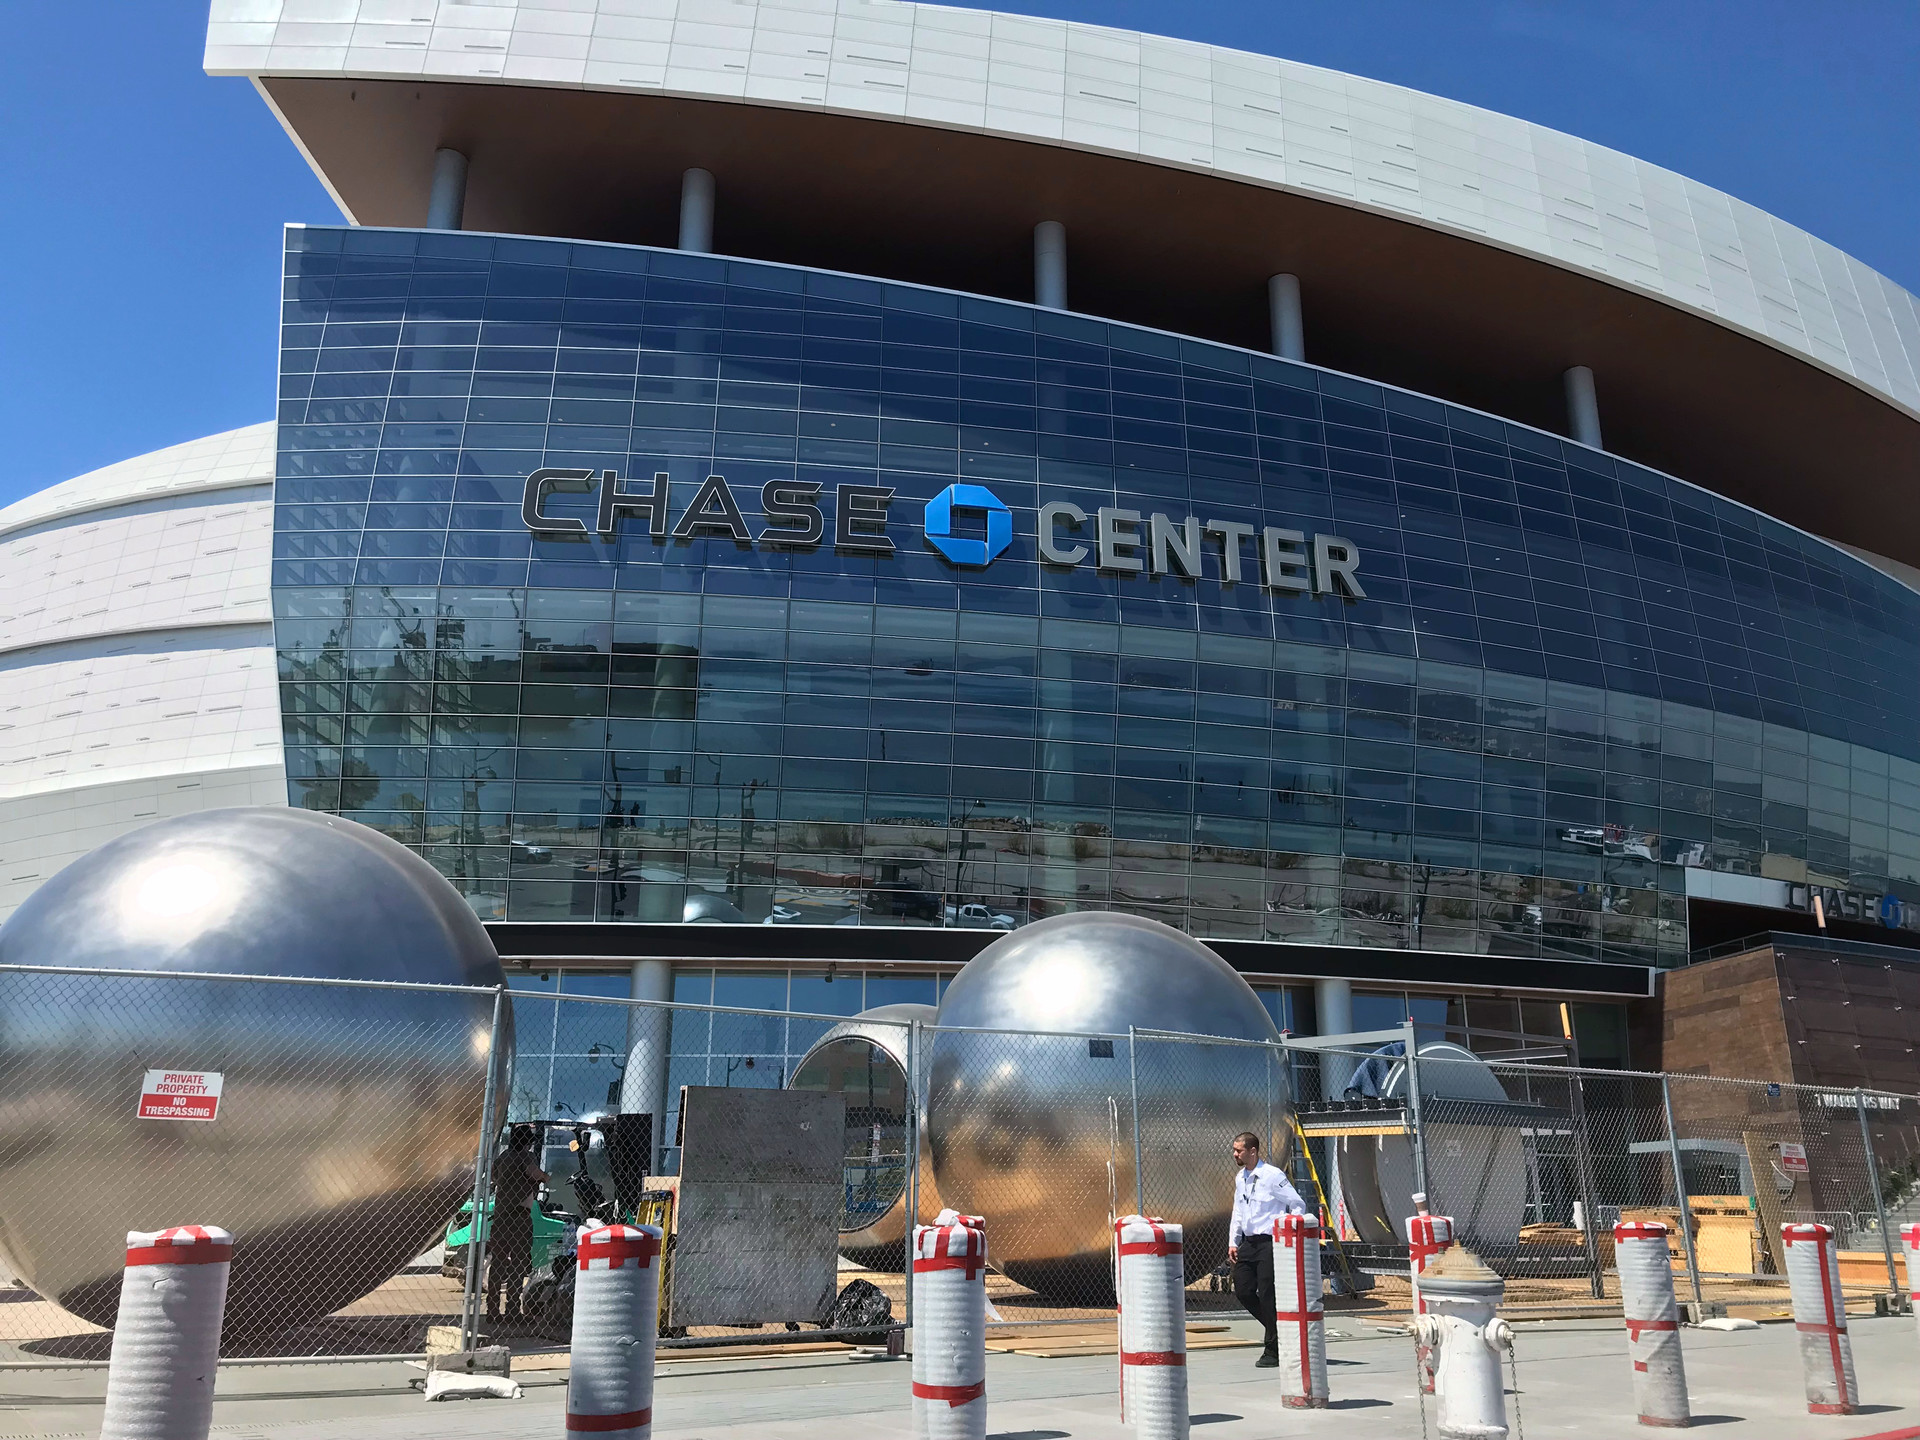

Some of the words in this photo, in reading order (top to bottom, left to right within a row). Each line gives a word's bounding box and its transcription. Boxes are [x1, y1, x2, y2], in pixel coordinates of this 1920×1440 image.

[521, 467, 897, 551] CHASE
[1037, 500, 1367, 600] CENTER
[1787, 880, 1883, 922] CHASE
[163, 1073, 205, 1084] PRIVATE
[156, 1083, 208, 1094] PROPERTY
[172, 1096, 187, 1106] NO
[145, 1105, 210, 1117] TRESPASSING
